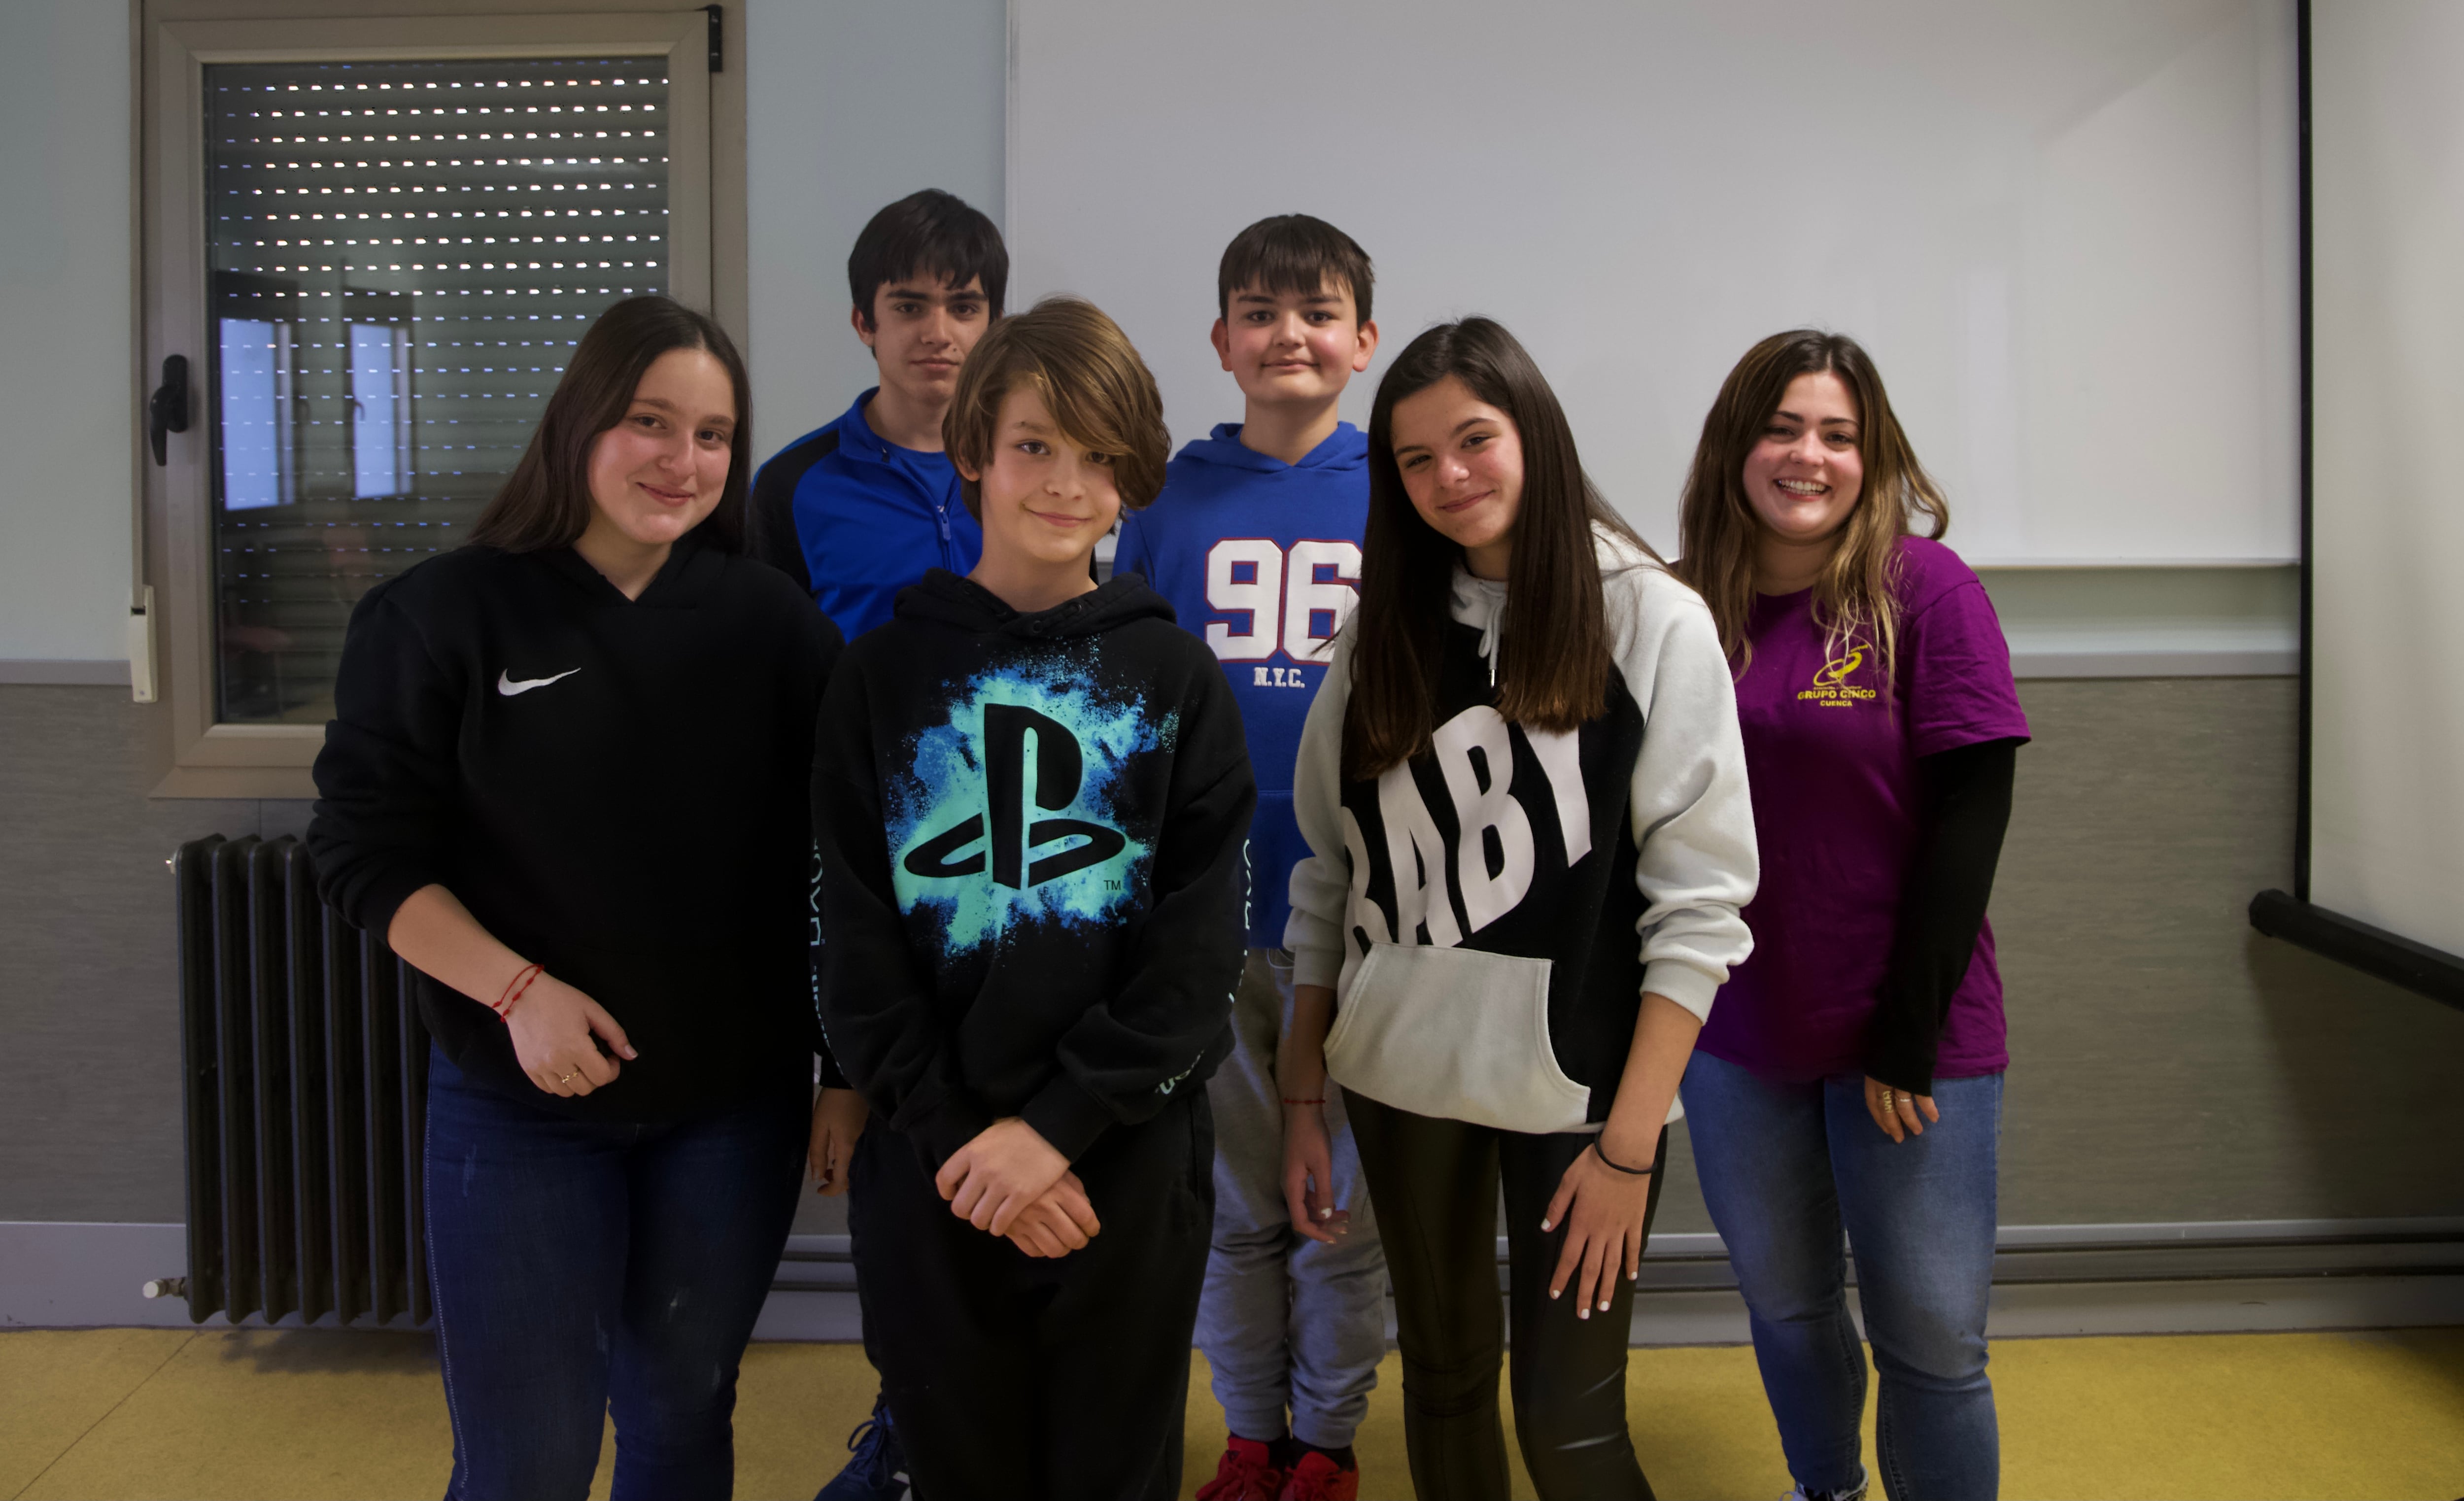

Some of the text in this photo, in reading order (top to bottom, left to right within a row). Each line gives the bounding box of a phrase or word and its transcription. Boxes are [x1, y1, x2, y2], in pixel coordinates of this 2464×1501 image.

[1204, 537, 1363, 665] 96
[1254, 667, 1305, 688] N.Y.C.
[1797, 689, 1876, 700] GRUPO CINCO
[1103, 880, 1121, 890] TM
